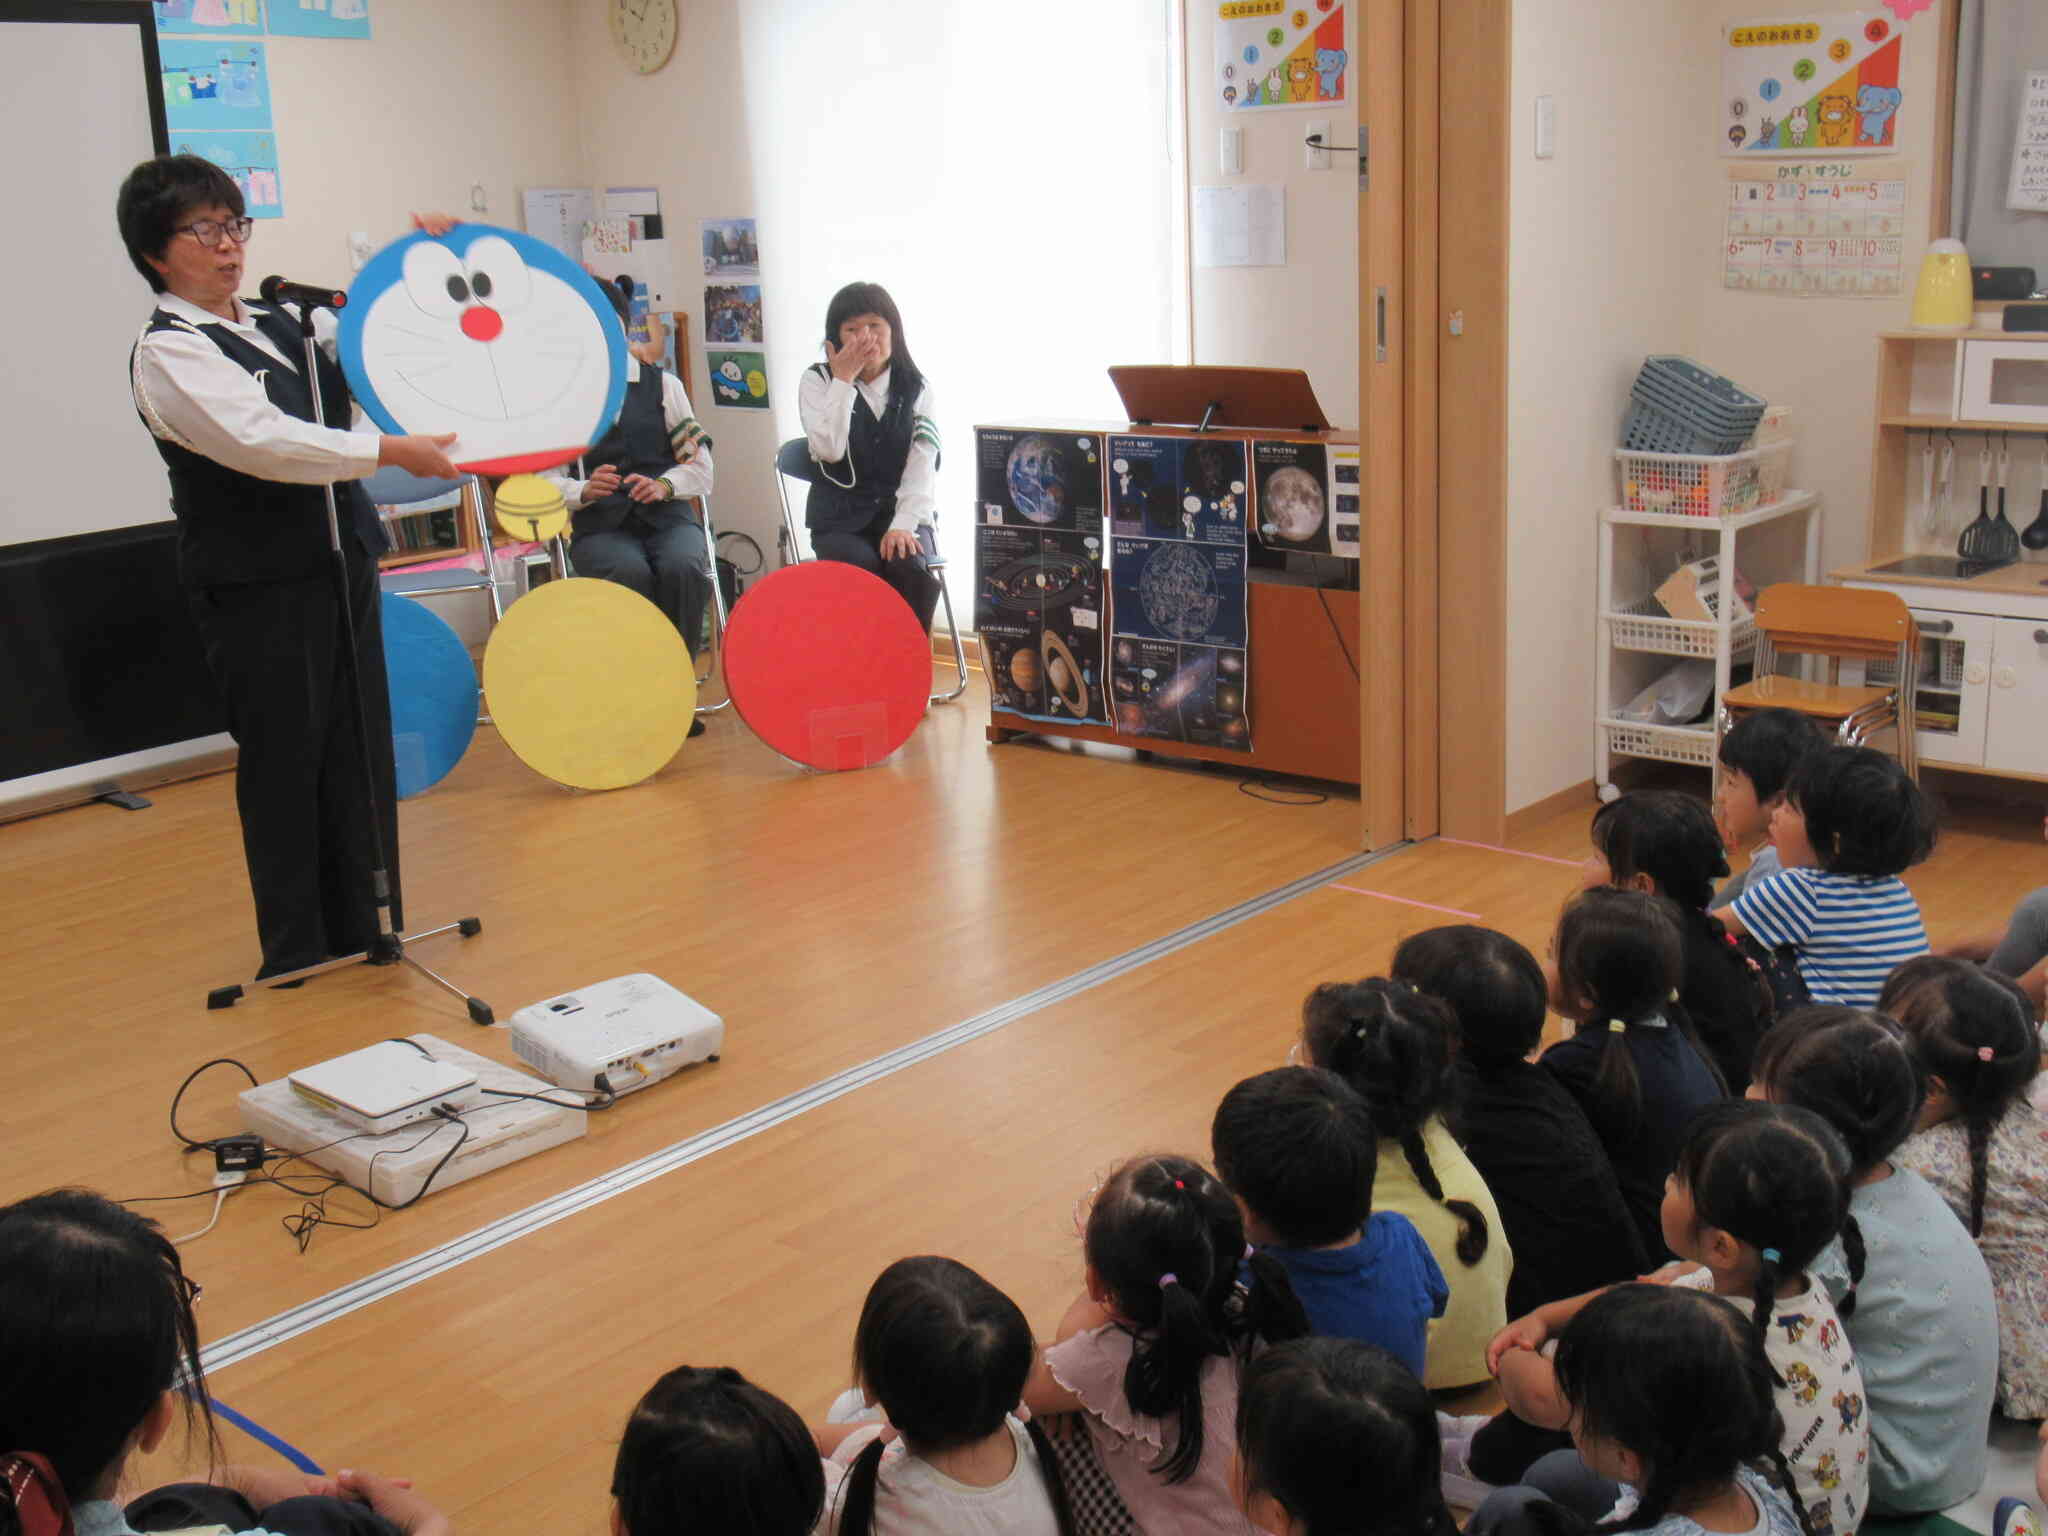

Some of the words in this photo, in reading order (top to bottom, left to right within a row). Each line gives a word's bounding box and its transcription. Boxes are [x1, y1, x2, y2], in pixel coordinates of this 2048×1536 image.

[1295, 13, 1305, 27] 3
[1271, 31, 1281, 45] 2
[1835, 43, 1845, 58] 3
[1225, 65, 1234, 79] 0
[1798, 63, 1809, 78] 2
[1733, 101, 1744, 116] 0
[1766, 183, 1775, 201] 2
[1798, 183, 1807, 201] 3
[1831, 183, 1841, 200] 4
[1869, 182, 1879, 201] 5
[1728, 241, 1738, 256] 6
[1764, 238, 1773, 256] 7
[1796, 239, 1803, 257] 8
[1828, 239, 1838, 257] 9
[1863, 239, 1877, 257] 10
